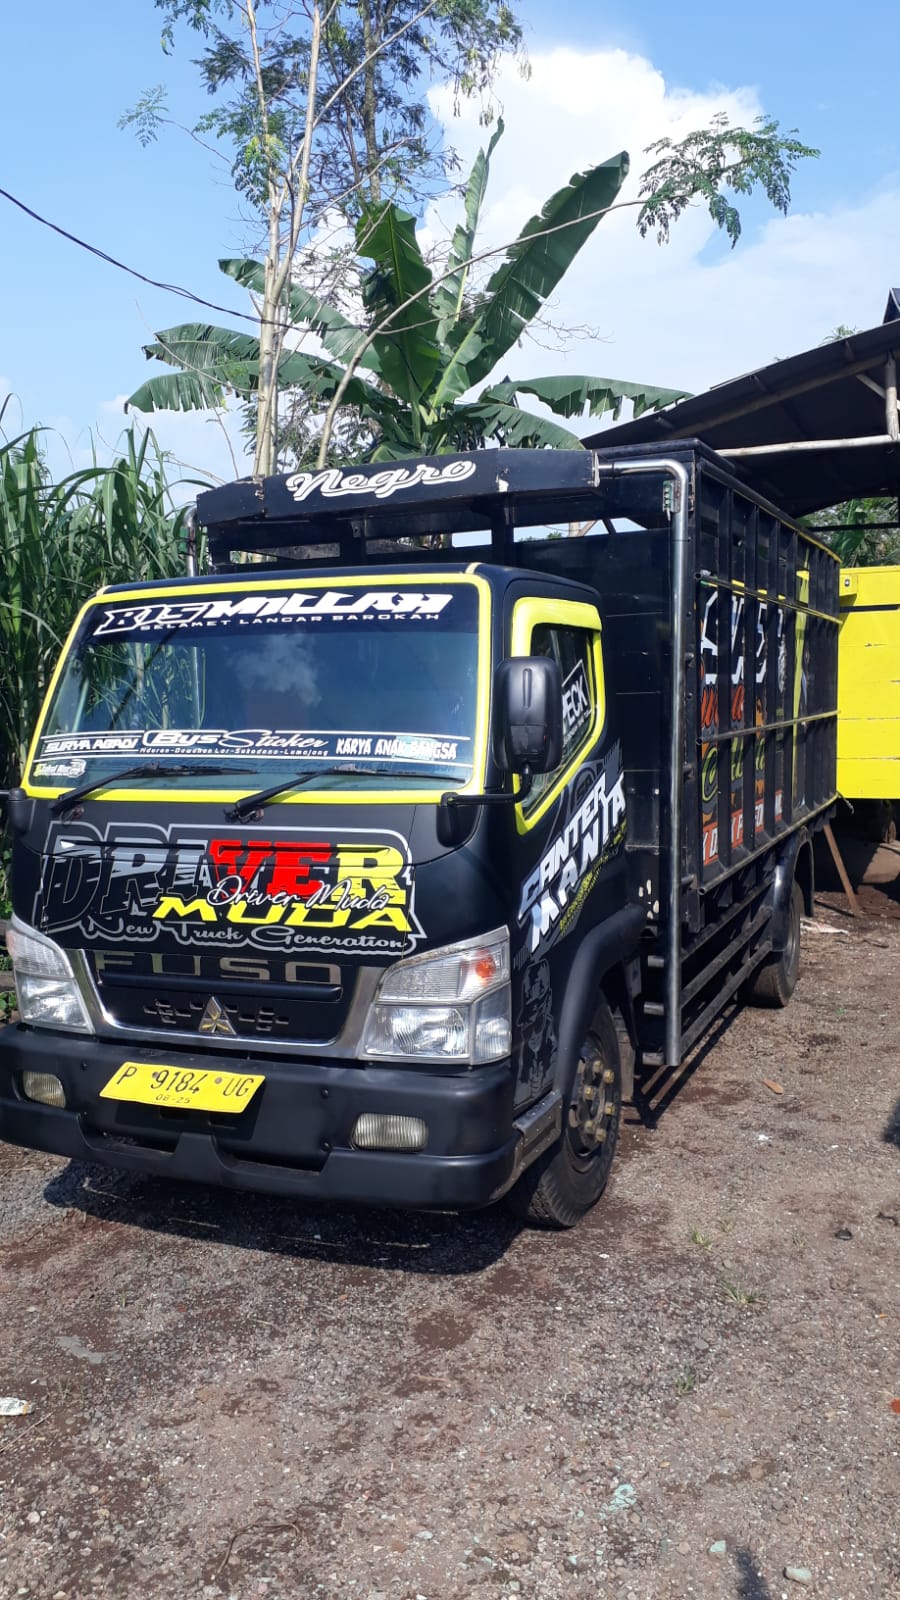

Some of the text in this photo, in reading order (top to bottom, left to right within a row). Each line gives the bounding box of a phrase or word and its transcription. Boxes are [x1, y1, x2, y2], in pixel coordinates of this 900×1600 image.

[286, 460, 477, 501] Negro
[140, 613, 440, 631] SELAMET LANCAR BAROKAH
[336, 738, 371, 755] KARYA
[518, 772, 609, 920] CANTER
[41, 834, 407, 930] DRIVER
[207, 875, 391, 911] Driver Muda
[87, 914, 408, 949] New Truck Generation
[152, 896, 413, 932] MUDA
[94, 951, 341, 985] FUSO
[116, 1066, 254, 1097] P 9184 UG
